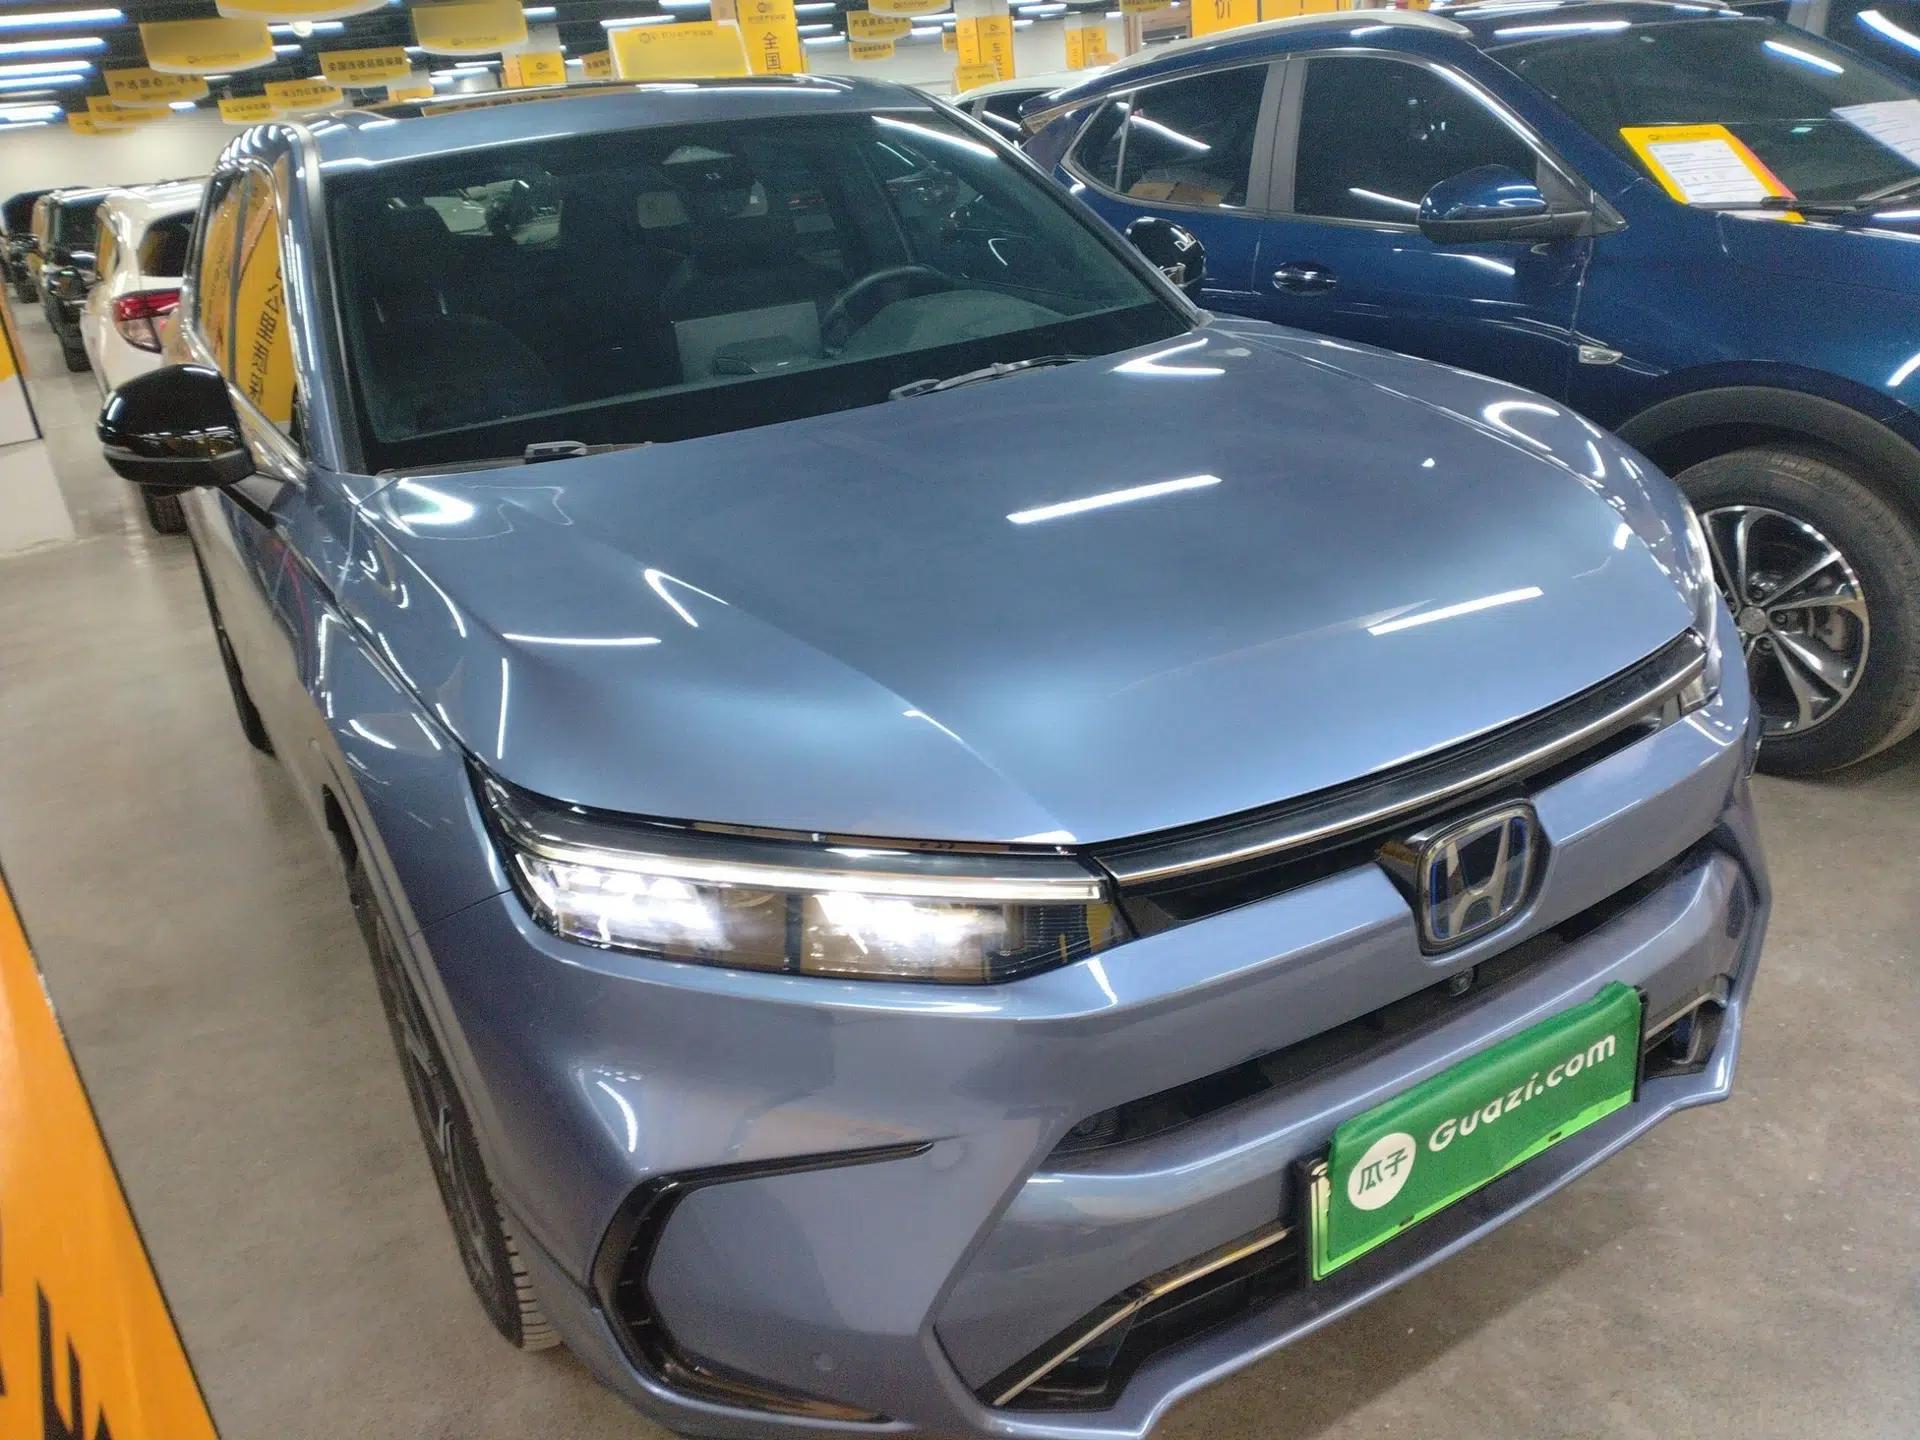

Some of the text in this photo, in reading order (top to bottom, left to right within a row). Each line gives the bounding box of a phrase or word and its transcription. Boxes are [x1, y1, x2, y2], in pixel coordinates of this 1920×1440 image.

[762, 31, 781, 75] 全国
[1428, 1034, 1616, 1152] Guazi.com
[1357, 1148, 1408, 1196] 瓜子
